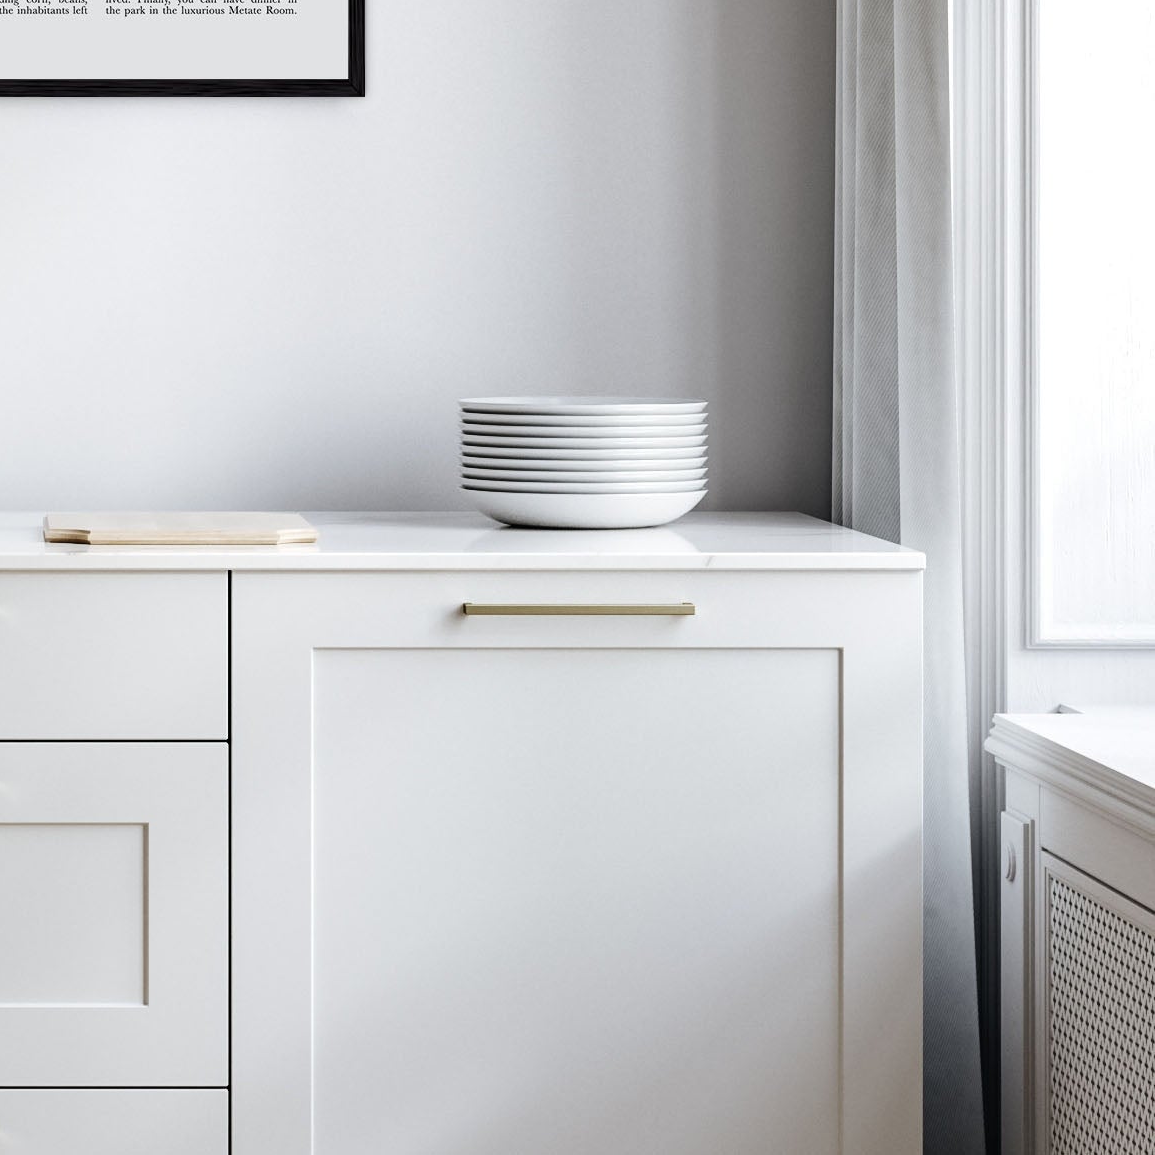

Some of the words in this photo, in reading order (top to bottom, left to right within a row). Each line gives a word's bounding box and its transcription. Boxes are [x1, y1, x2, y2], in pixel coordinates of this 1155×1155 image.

[0, 6, 14, 15] the
[17, 6, 70, 15] inhabitants
[73, 6, 88, 15] left
[106, 6, 121, 15] the
[124, 6, 146, 17] park
[149, 6, 159, 15] in
[162, 6, 178, 15] the
[181, 6, 225, 15] luxurious
[229, 6, 262, 15] Metate
[266, 6, 297, 15] Room.
